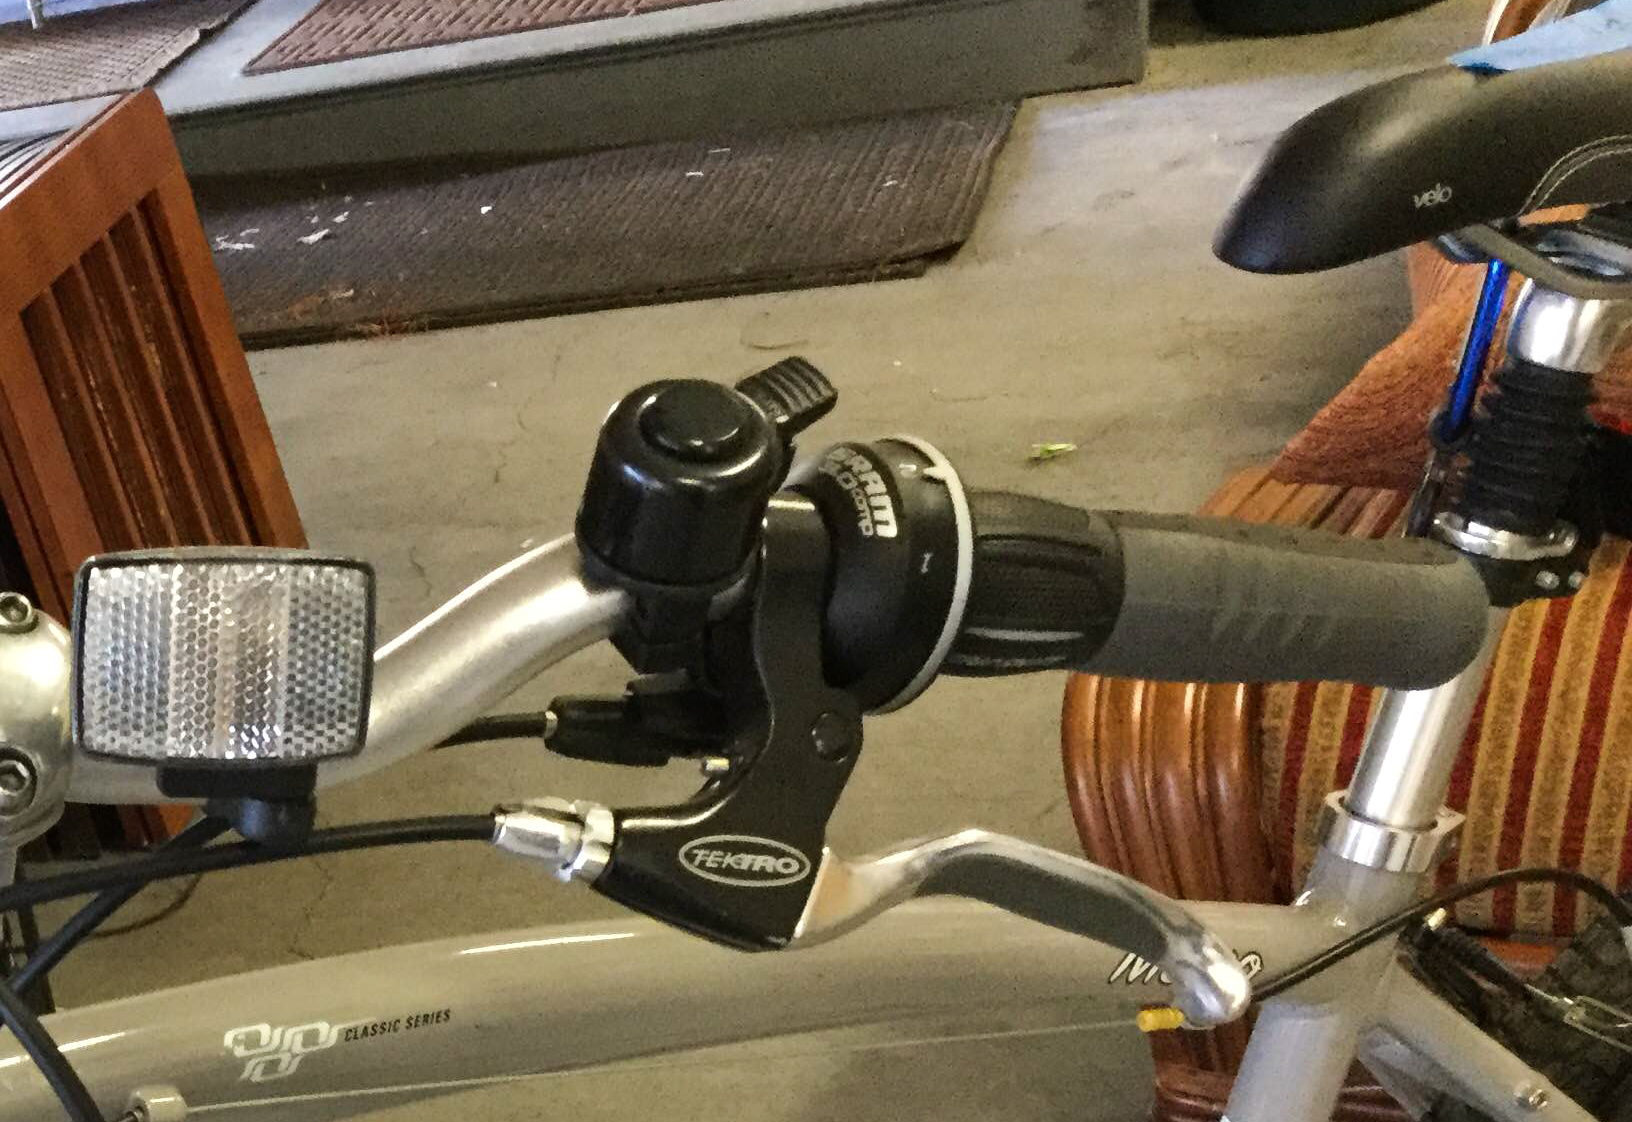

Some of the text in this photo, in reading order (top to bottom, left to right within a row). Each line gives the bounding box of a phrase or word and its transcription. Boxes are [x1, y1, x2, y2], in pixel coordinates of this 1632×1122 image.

[1412, 183, 1452, 209] velo
[693, 849, 800, 875] TEKTRO
[343, 1007, 452, 1043] CLASSIC SERIES
